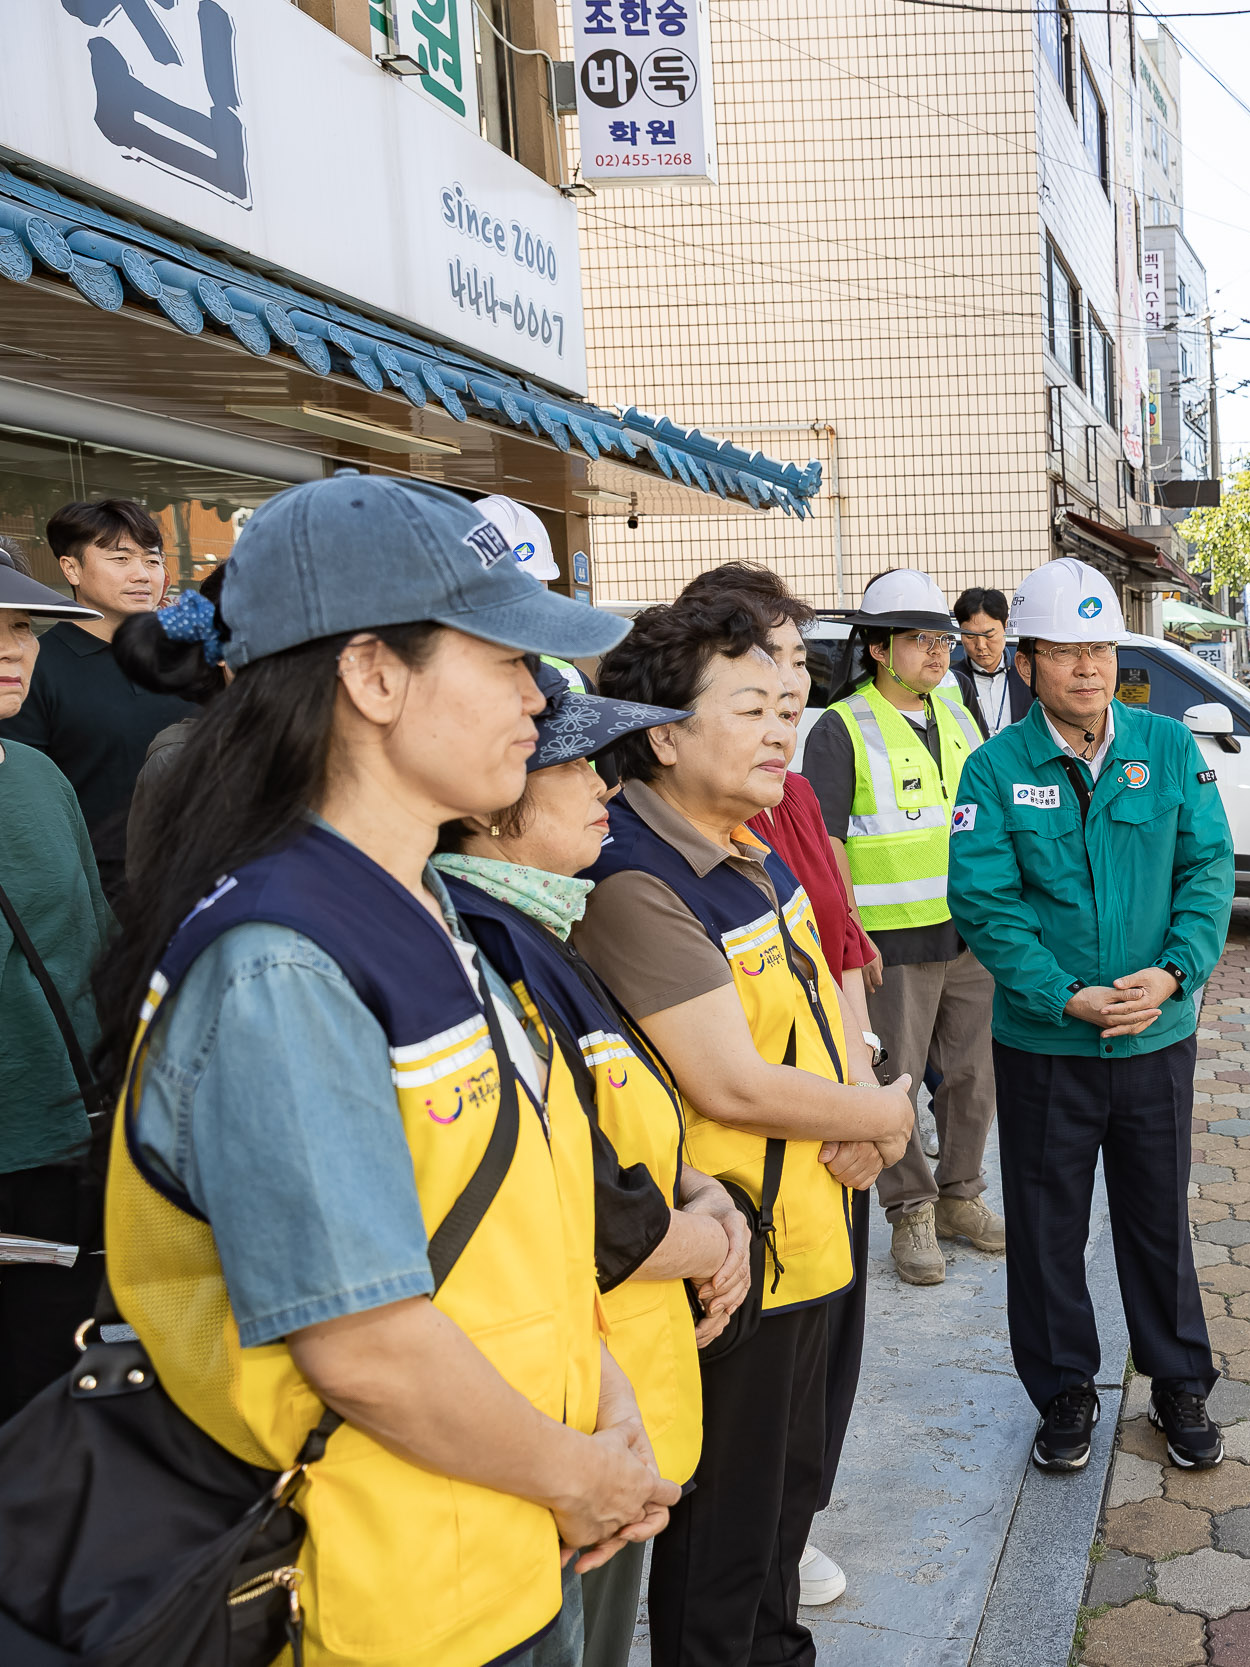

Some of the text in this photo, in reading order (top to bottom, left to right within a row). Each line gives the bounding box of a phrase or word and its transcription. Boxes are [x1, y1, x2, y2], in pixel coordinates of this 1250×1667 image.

[584, 0, 687, 37] 조한승
[581, 48, 697, 108] 바둑
[608, 120, 676, 147] 학원
[594, 152, 692, 168] 02)455-1268
[443, 187, 556, 281] since 2000
[450, 259, 563, 356] 444-0007
